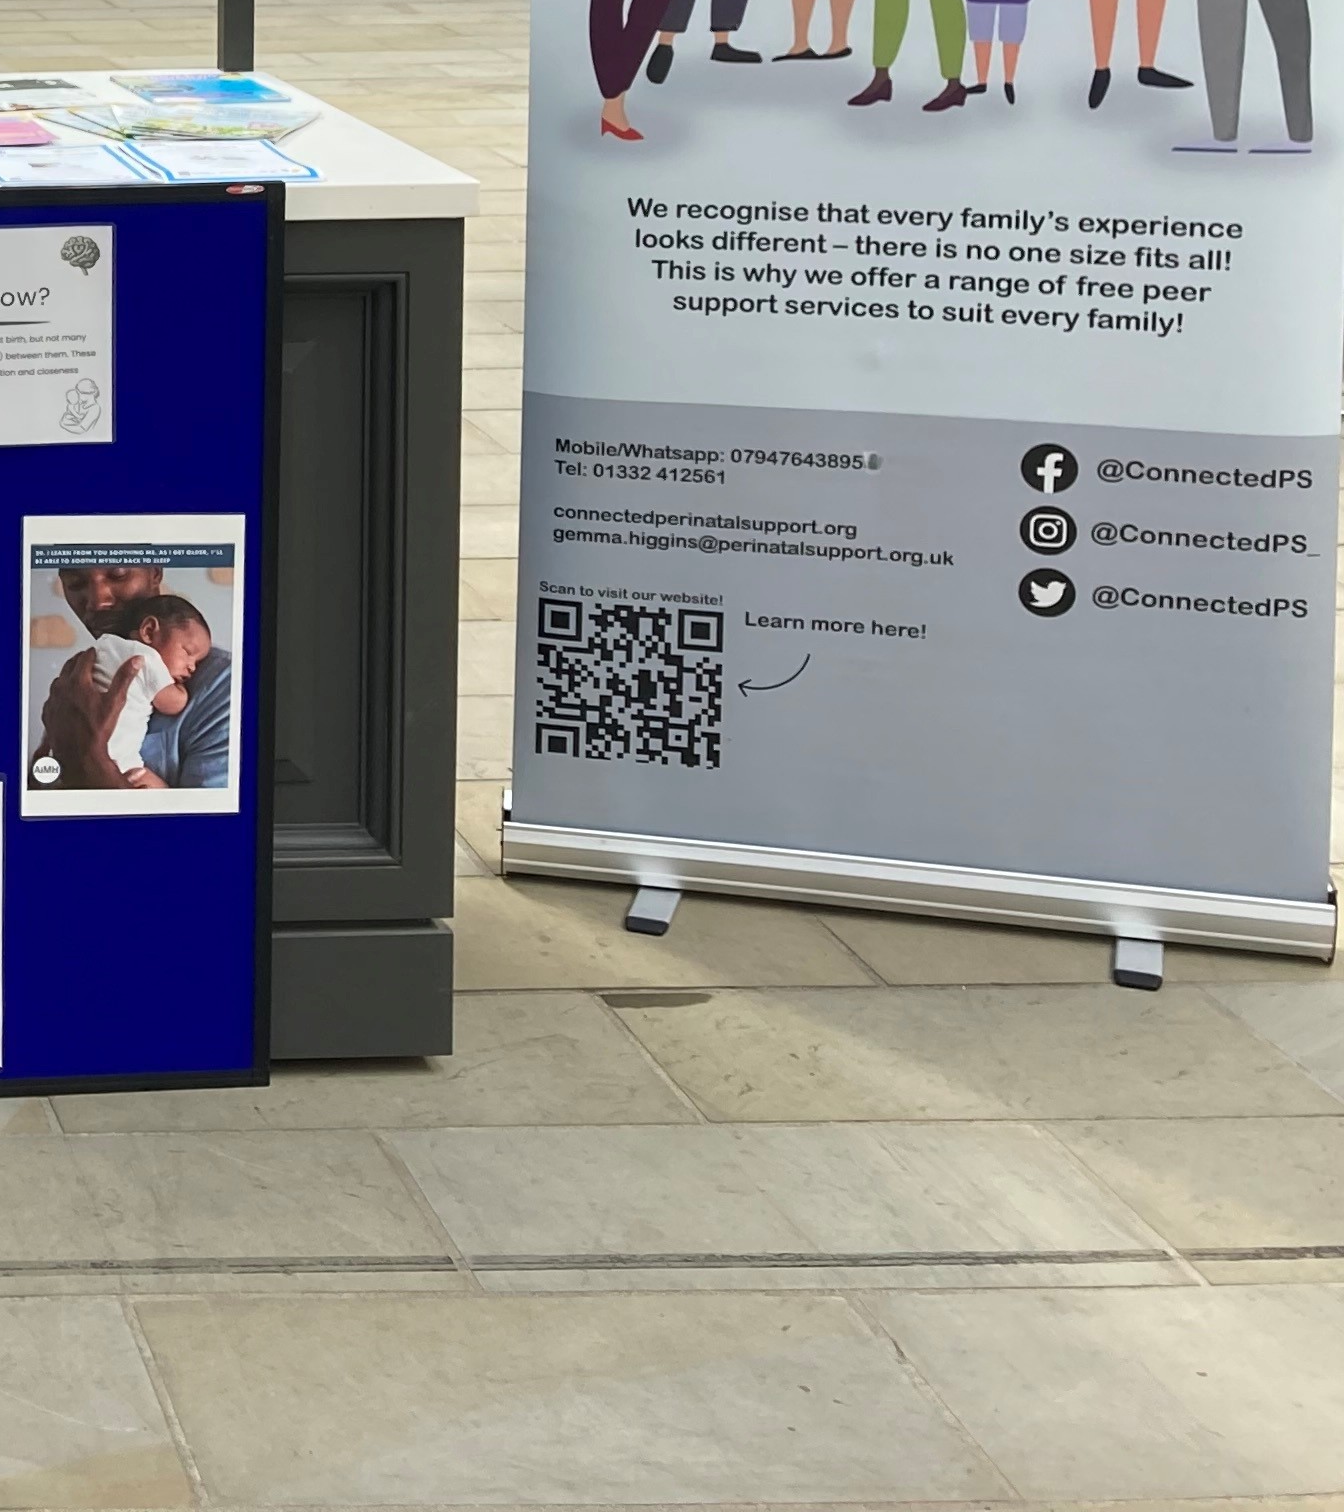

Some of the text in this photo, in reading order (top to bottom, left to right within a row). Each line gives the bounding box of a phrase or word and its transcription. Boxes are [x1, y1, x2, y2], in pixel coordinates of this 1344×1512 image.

[627, 197, 1243, 240] We recognise that every family's experience
[553, 437, 725, 465] Mobile/Whatsapp:
[553, 459, 725, 485] Tel: 01332 412561
[1096, 458, 1313, 489] @ConnectedPS
[553, 506, 857, 540] connectedperinatalsupport.org
[1090, 521, 1317, 557] @ConnectedPS_
[552, 528, 954, 567] gemma.higgins@perinatalsupport.org.uk
[538, 580, 723, 606] Scan to visit our website!
[1092, 585, 1308, 619] @ConnectedPS
